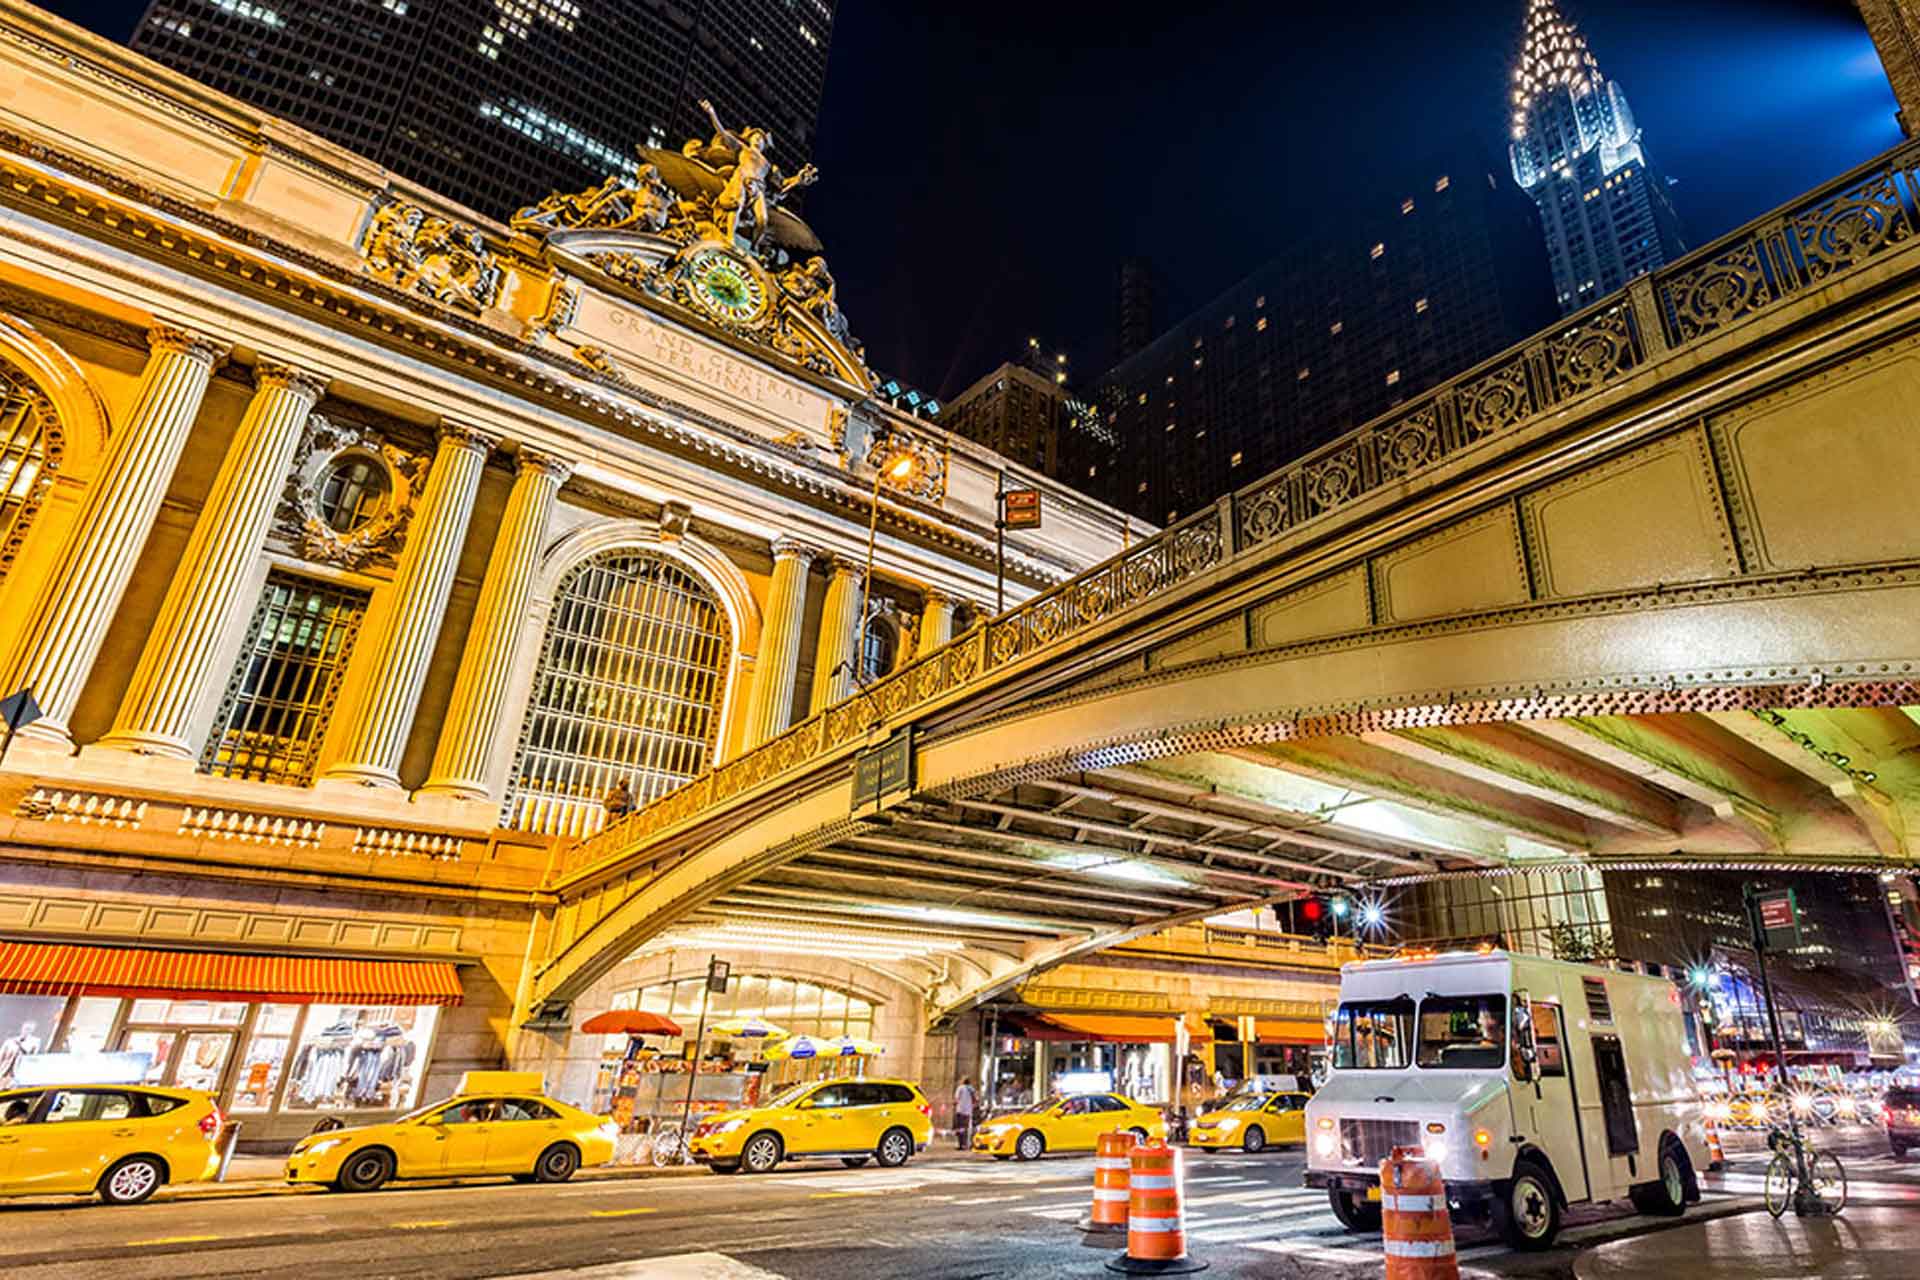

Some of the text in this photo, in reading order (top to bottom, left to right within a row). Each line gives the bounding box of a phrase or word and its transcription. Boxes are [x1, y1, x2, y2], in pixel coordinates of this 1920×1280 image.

[610, 310, 804, 405] GRAND CENTRAL
[656, 345, 762, 401] TERMINAL
